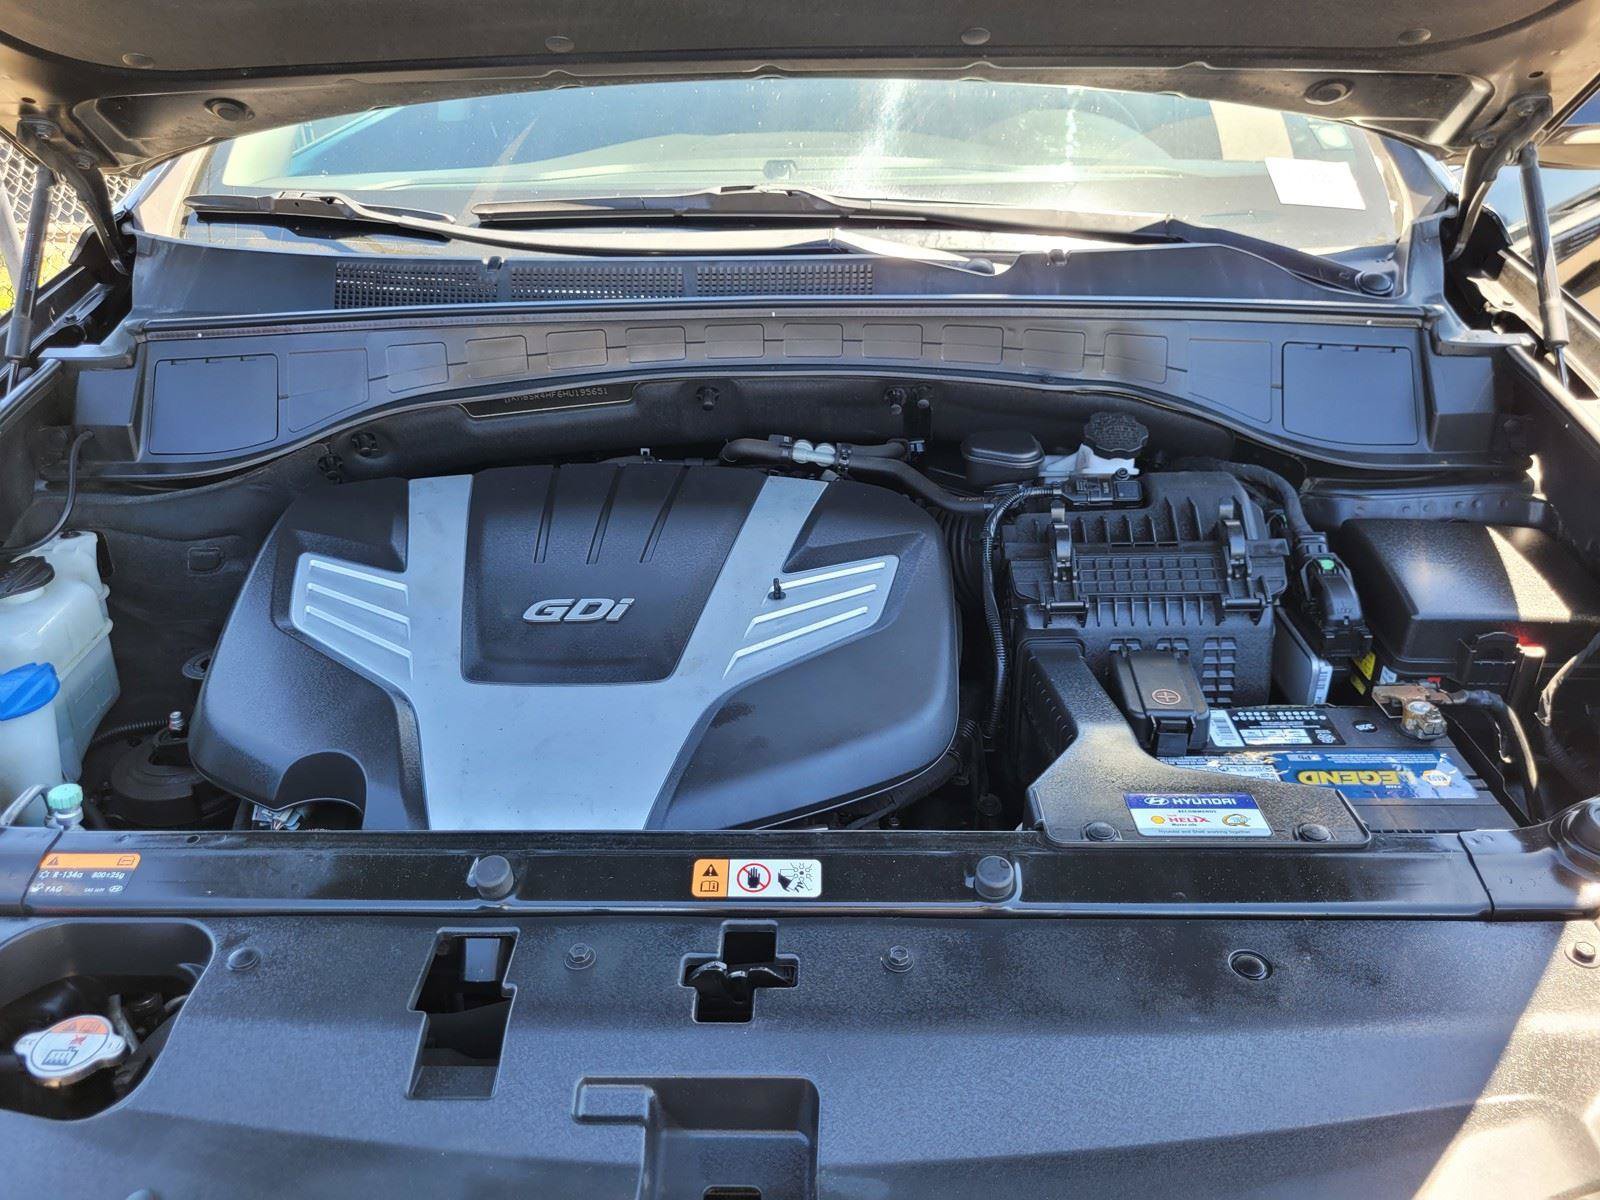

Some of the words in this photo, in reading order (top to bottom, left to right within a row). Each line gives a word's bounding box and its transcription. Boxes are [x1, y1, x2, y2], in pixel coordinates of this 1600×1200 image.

[522, 598, 635, 622] GDi
[1298, 770, 1416, 785] LEGEND
[1172, 797, 1237, 805] HYUNDAI
